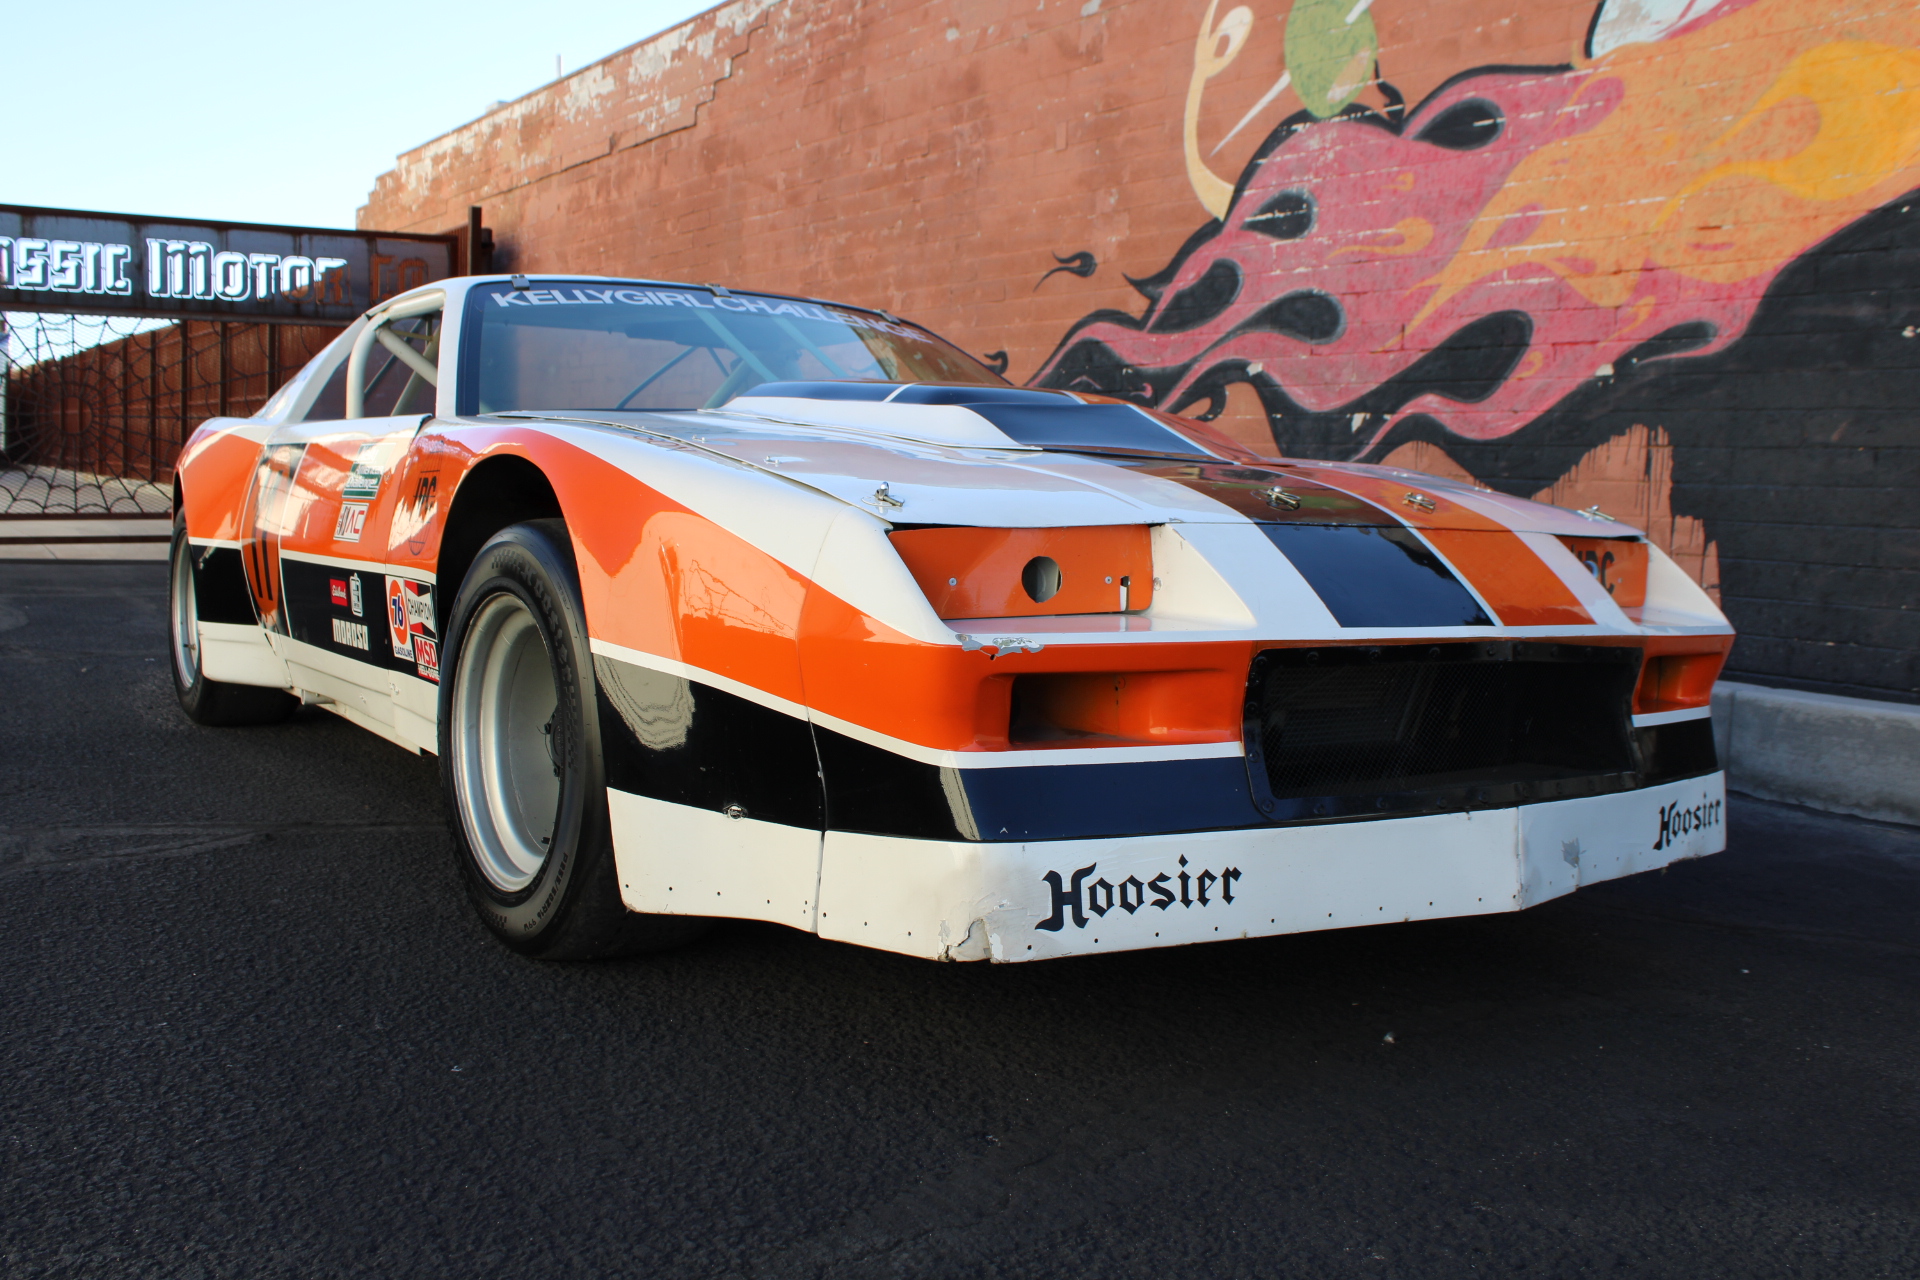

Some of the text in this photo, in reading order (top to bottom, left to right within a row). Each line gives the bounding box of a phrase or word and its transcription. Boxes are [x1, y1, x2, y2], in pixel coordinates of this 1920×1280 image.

[713, 296, 932, 344] CHALLENGE
[392, 593, 404, 630] 76
[407, 598, 433, 620] CHAMPION
[394, 645, 413, 659] GASOLINE
[415, 638, 437, 668] MSD
[1653, 791, 1721, 850] Hoosier
[1034, 854, 1242, 932] Hoosier
